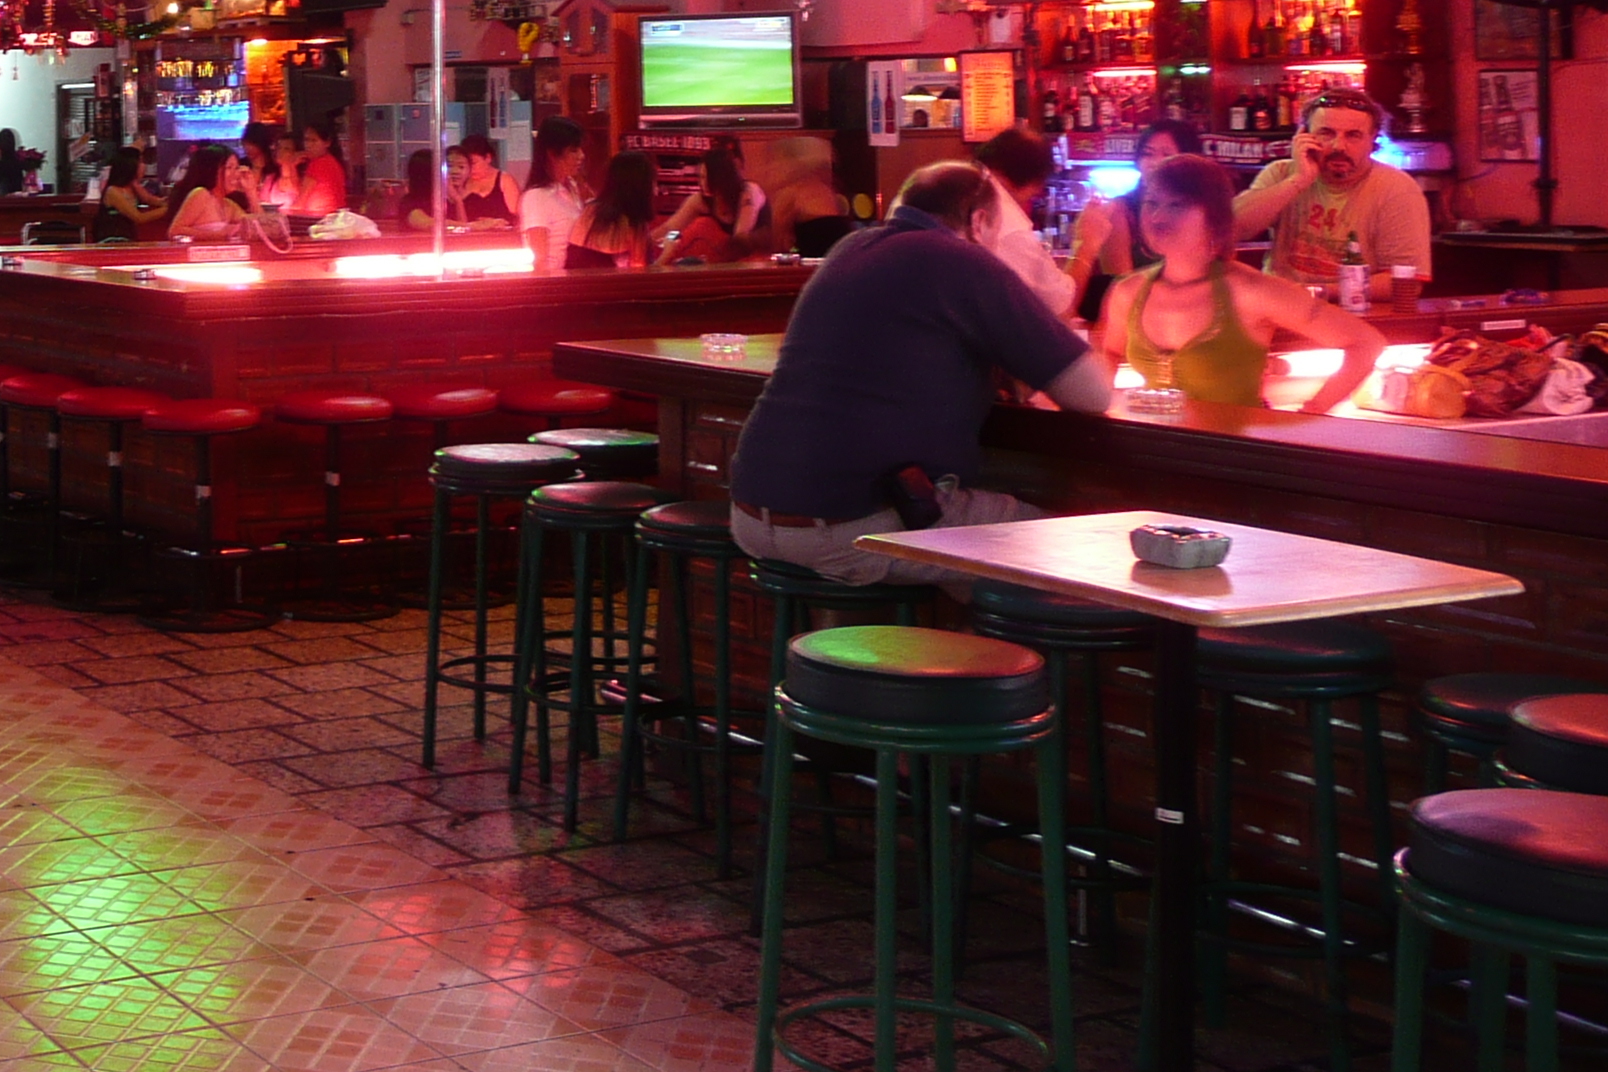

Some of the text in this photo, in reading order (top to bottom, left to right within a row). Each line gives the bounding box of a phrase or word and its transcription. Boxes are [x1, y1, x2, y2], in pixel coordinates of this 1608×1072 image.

[642, 136, 679, 148] BASEL
[1217, 141, 1263, 158] MILAN
[1309, 204, 1337, 230] 24
